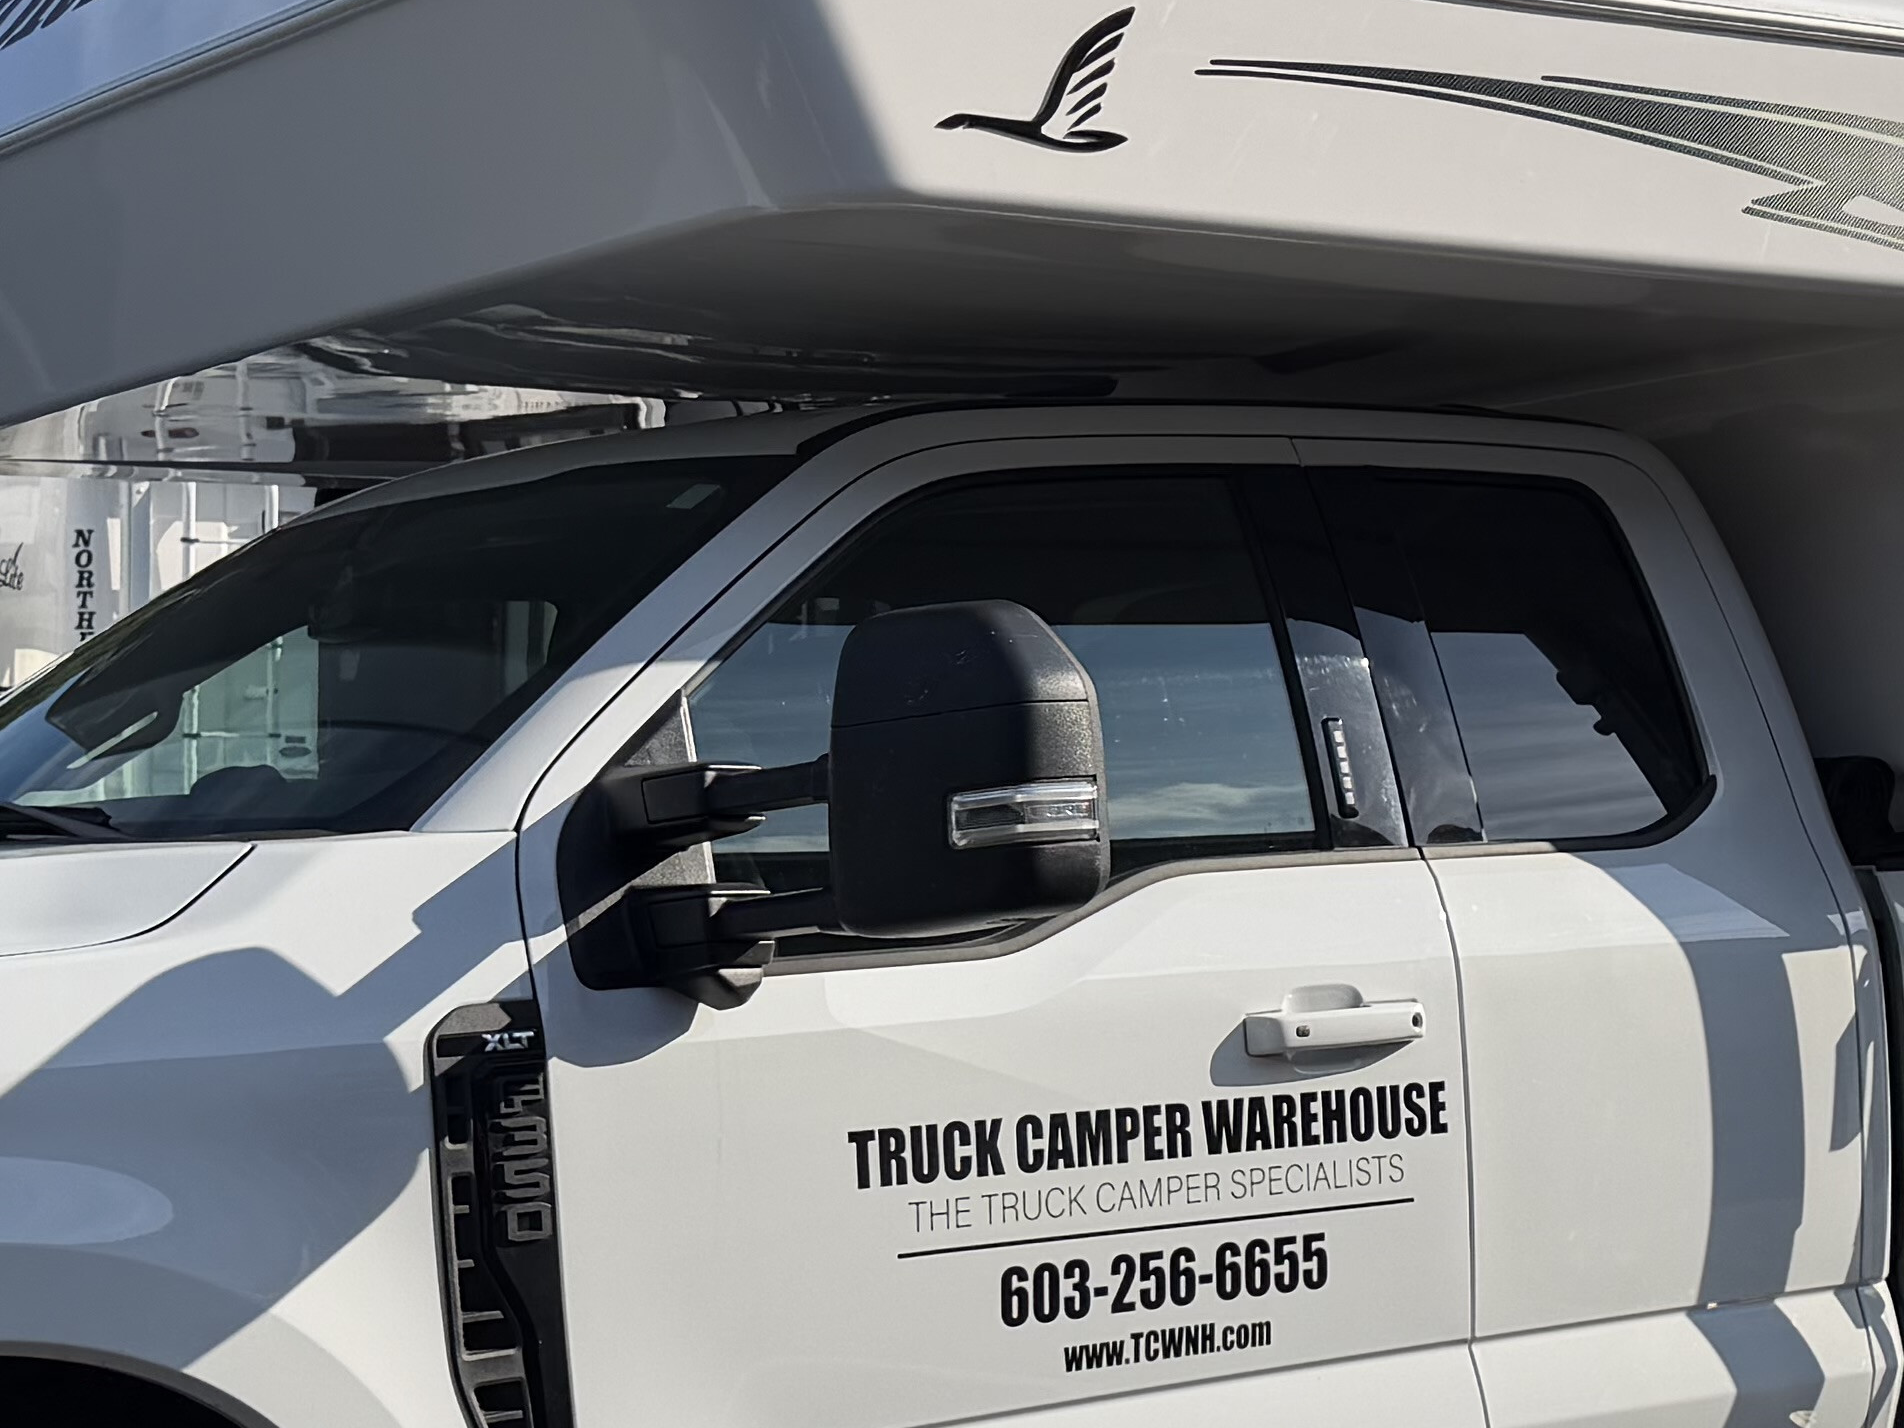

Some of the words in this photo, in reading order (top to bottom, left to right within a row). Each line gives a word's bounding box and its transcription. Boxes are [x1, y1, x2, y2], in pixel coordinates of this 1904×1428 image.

[481, 1029, 536, 1052] XLT
[848, 1118, 1005, 1189] TRUCK
[1015, 1103, 1192, 1174] CAMPER
[1201, 1081, 1448, 1152] WAREHOUSE
[908, 1196, 972, 1233] THE
[980, 1184, 1088, 1227] TRUCK
[1095, 1172, 1222, 1215] CAMPER
[1229, 1154, 1406, 1200] SPECIALISTS
[999, 1233, 1329, 1328] 603-256-6655
[1063, 1320, 1273, 1373] www.TCWNH.com
